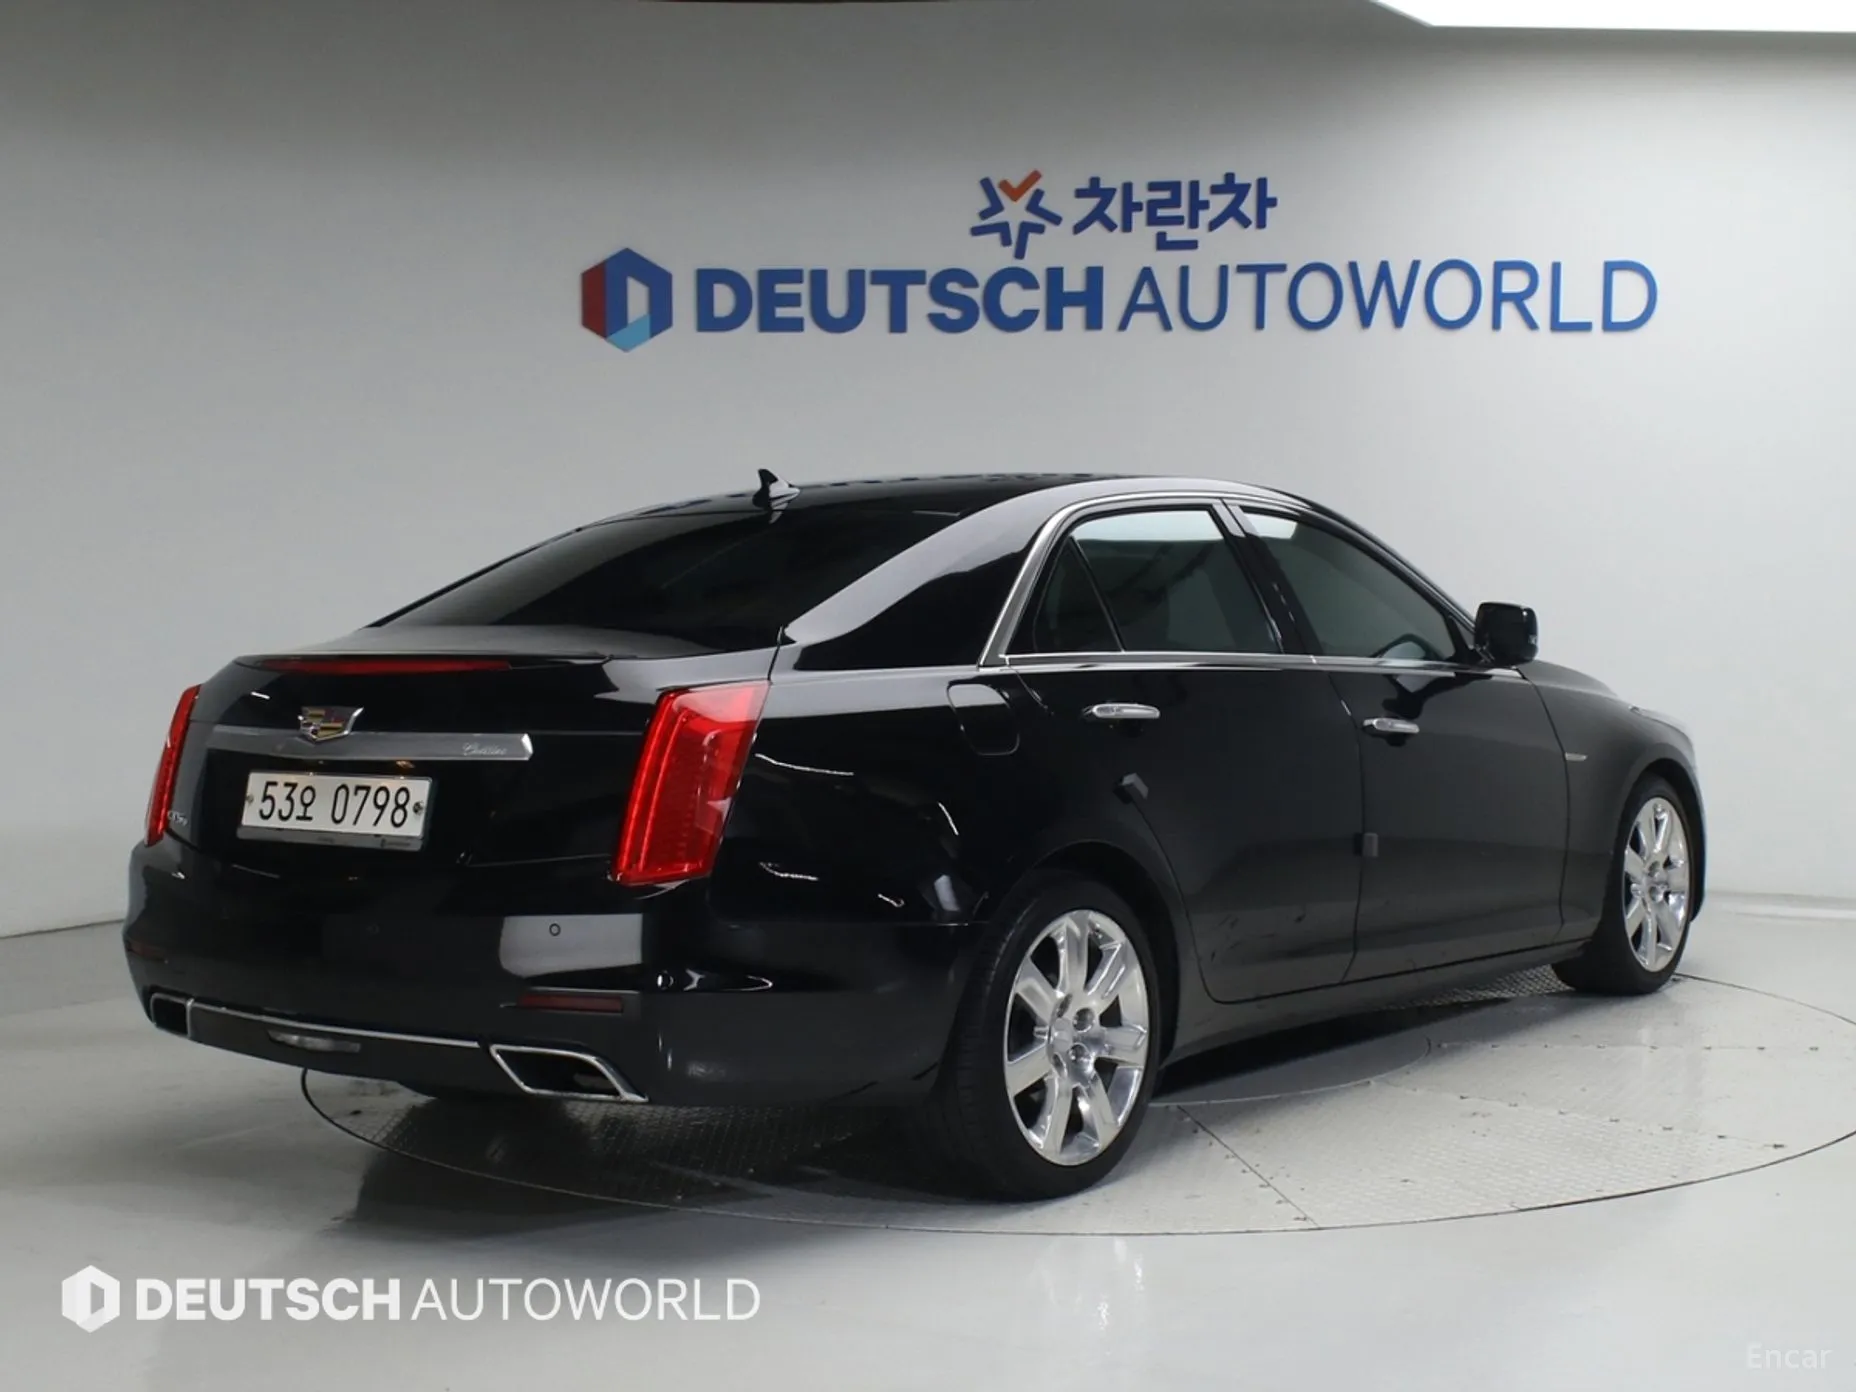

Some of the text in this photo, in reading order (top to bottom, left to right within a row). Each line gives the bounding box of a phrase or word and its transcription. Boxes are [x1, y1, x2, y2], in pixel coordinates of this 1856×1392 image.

[1073, 172, 1277, 250] 차란차
[696, 259, 1659, 334] DEUTSCH AUTOWORLD
[259, 781, 410, 828] 53오 0798
